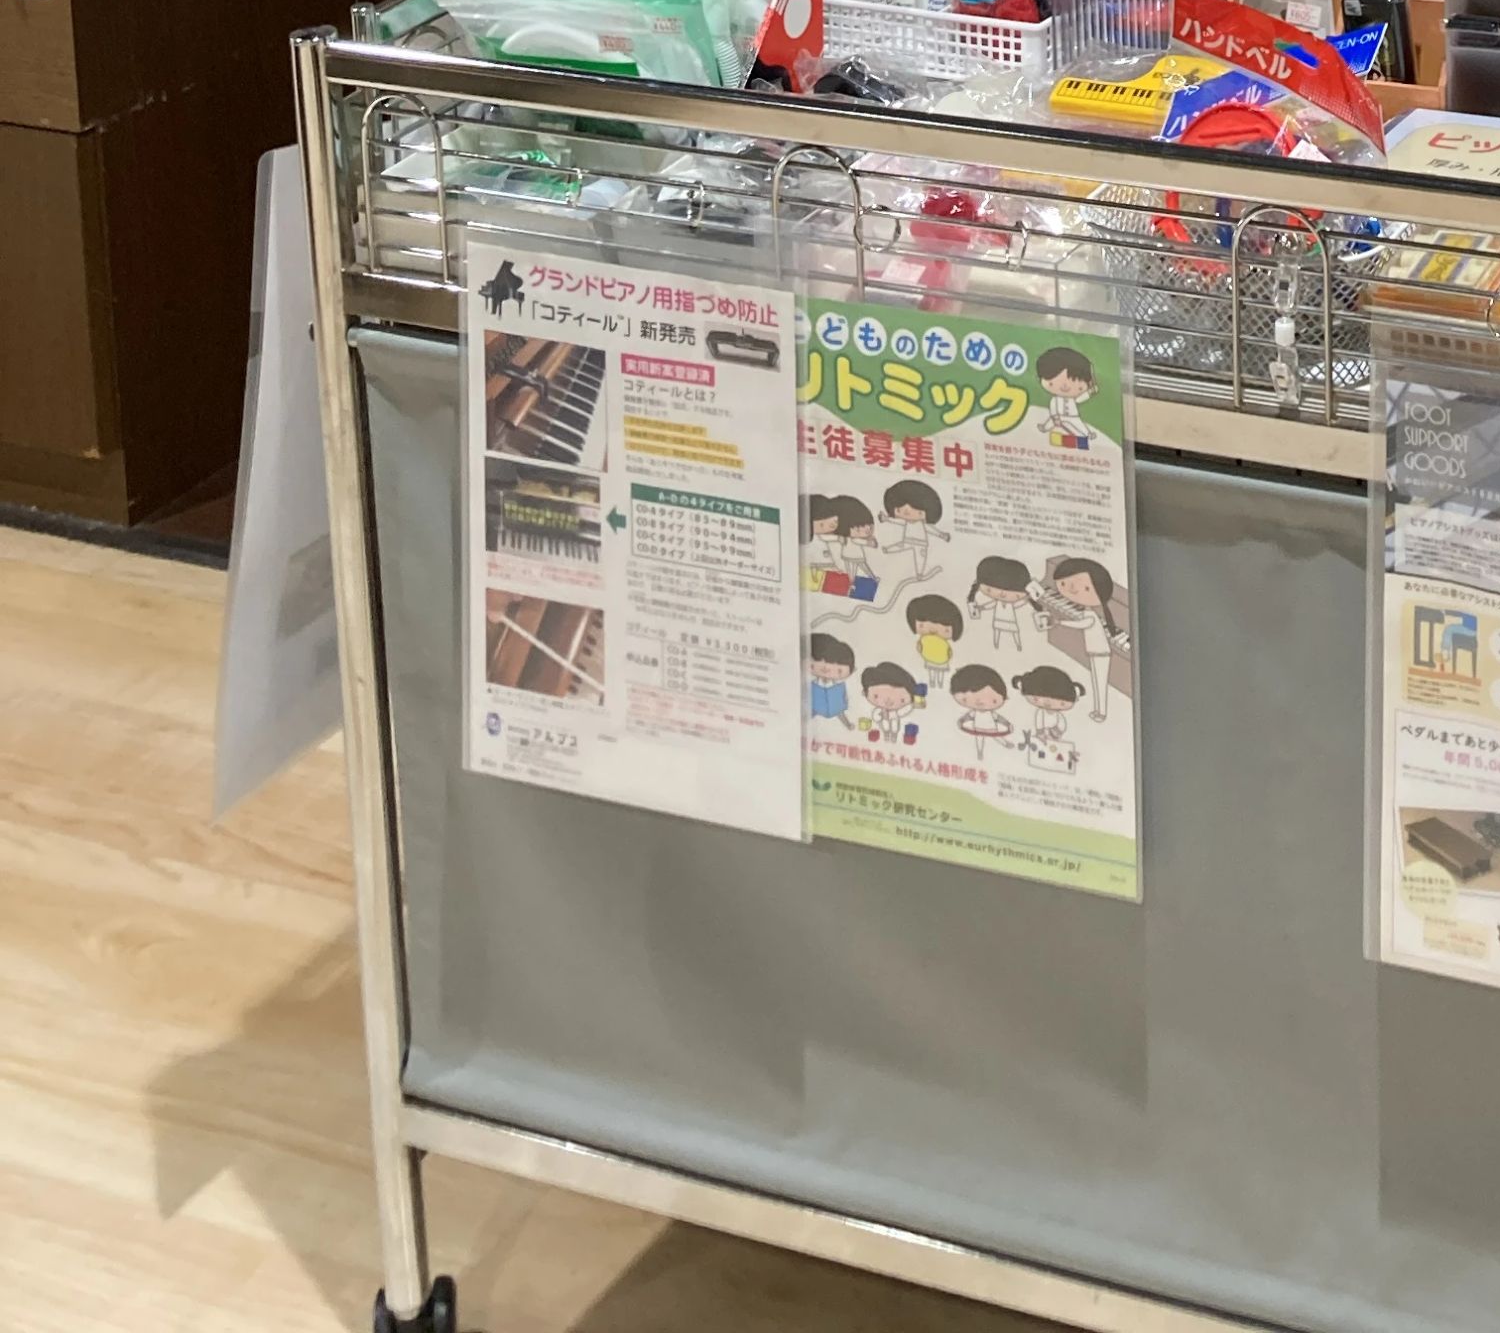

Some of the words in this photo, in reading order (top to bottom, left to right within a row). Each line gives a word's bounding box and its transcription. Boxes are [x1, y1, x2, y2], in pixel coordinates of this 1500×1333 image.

[1179, 18, 1291, 80] ハンドベル
[528, 264, 780, 328] グランドピアノ用指づめ防止
[639, 320, 697, 346] 新発売
[796, 352, 1029, 435] リトミック
[1403, 402, 1454, 425] FOOT
[1403, 429, 1469, 455] SUPPORT
[1402, 451, 1468, 479] GOODS
